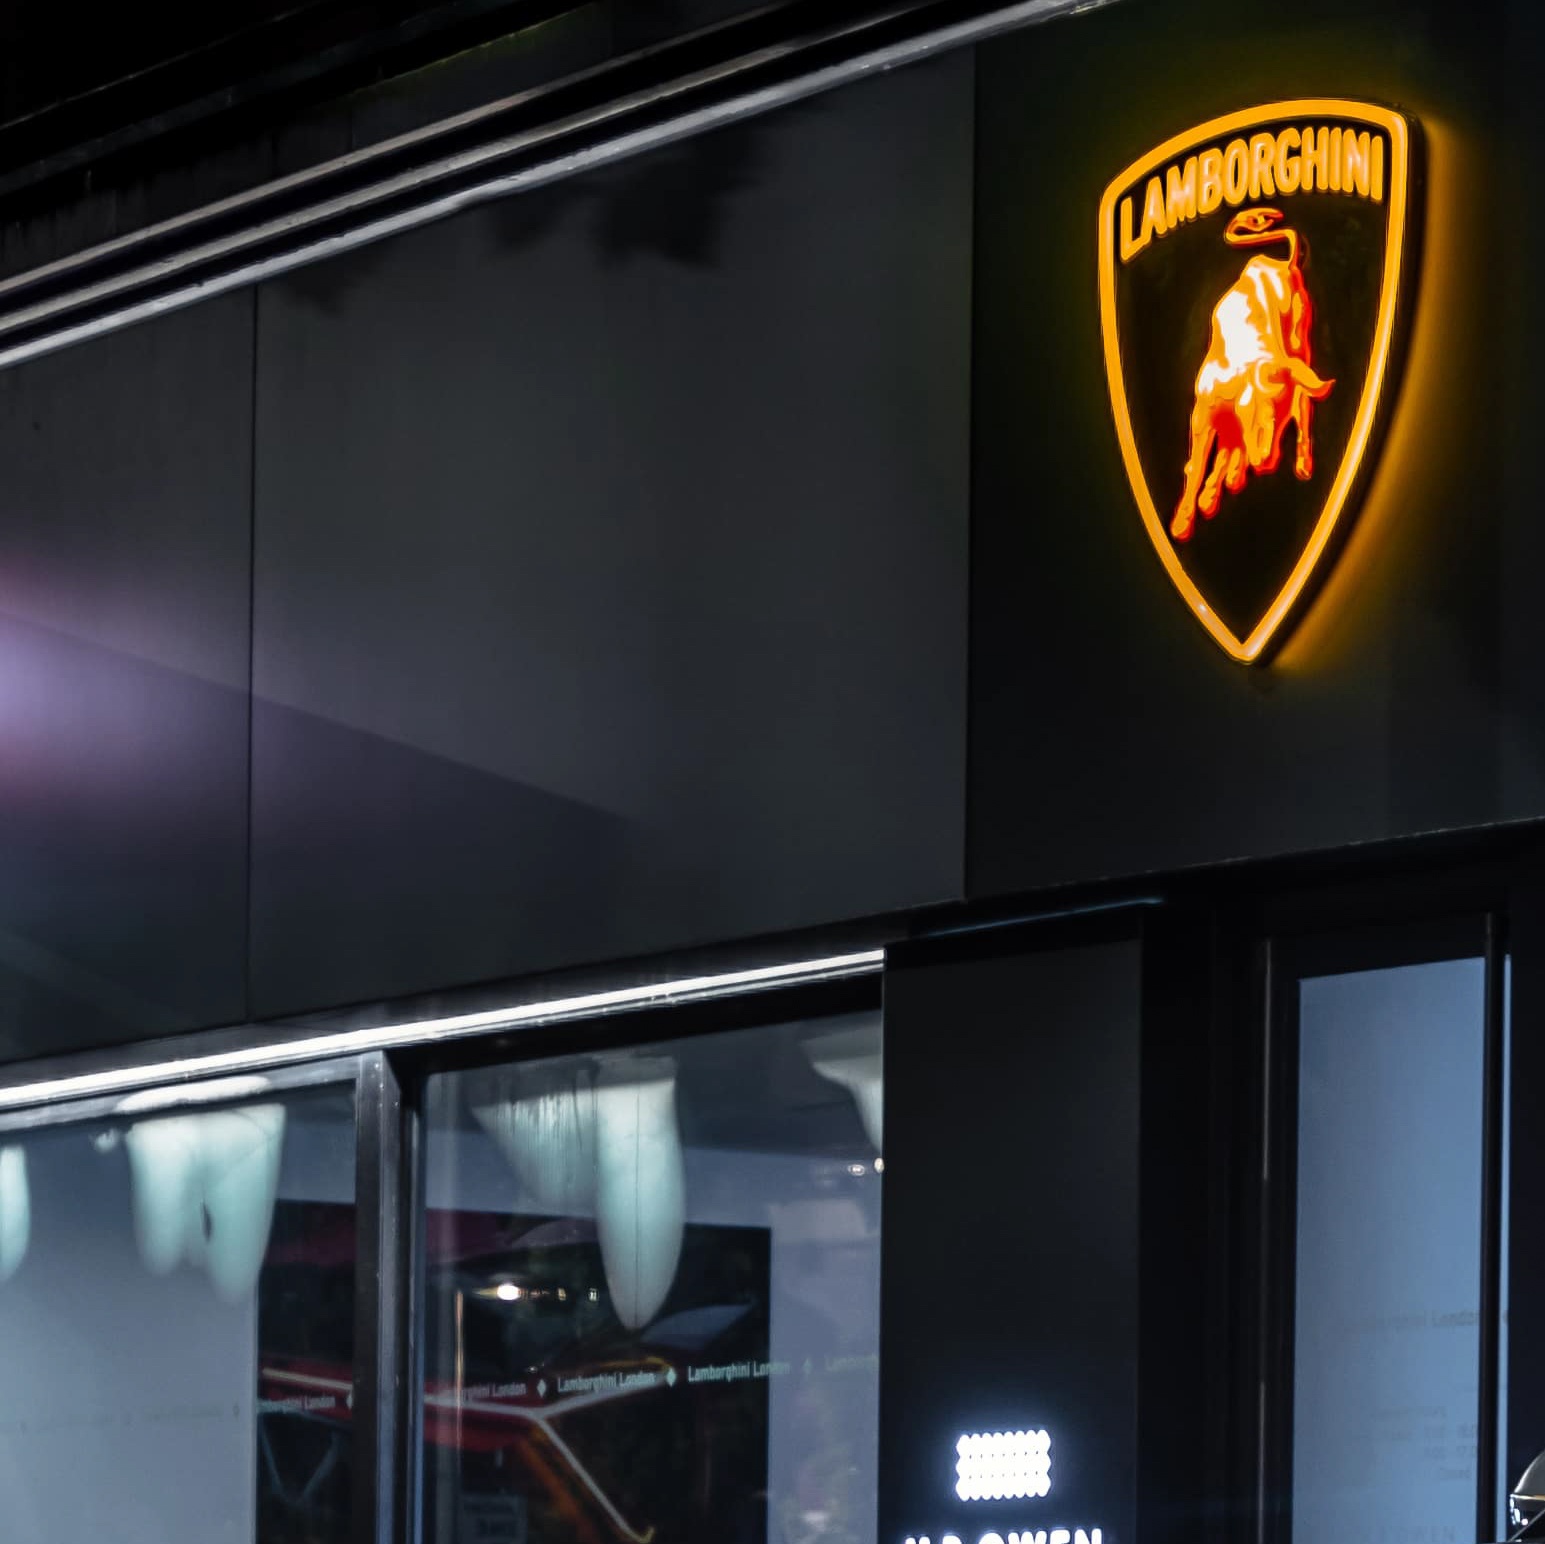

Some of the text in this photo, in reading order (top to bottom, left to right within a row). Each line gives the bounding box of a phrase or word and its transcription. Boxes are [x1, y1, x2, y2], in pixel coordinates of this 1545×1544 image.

[1118, 126, 1385, 264] LAMBORGHINI
[557, 1370, 656, 1393] Lamborghini London
[688, 1361, 750, 1382] Lamborghini
